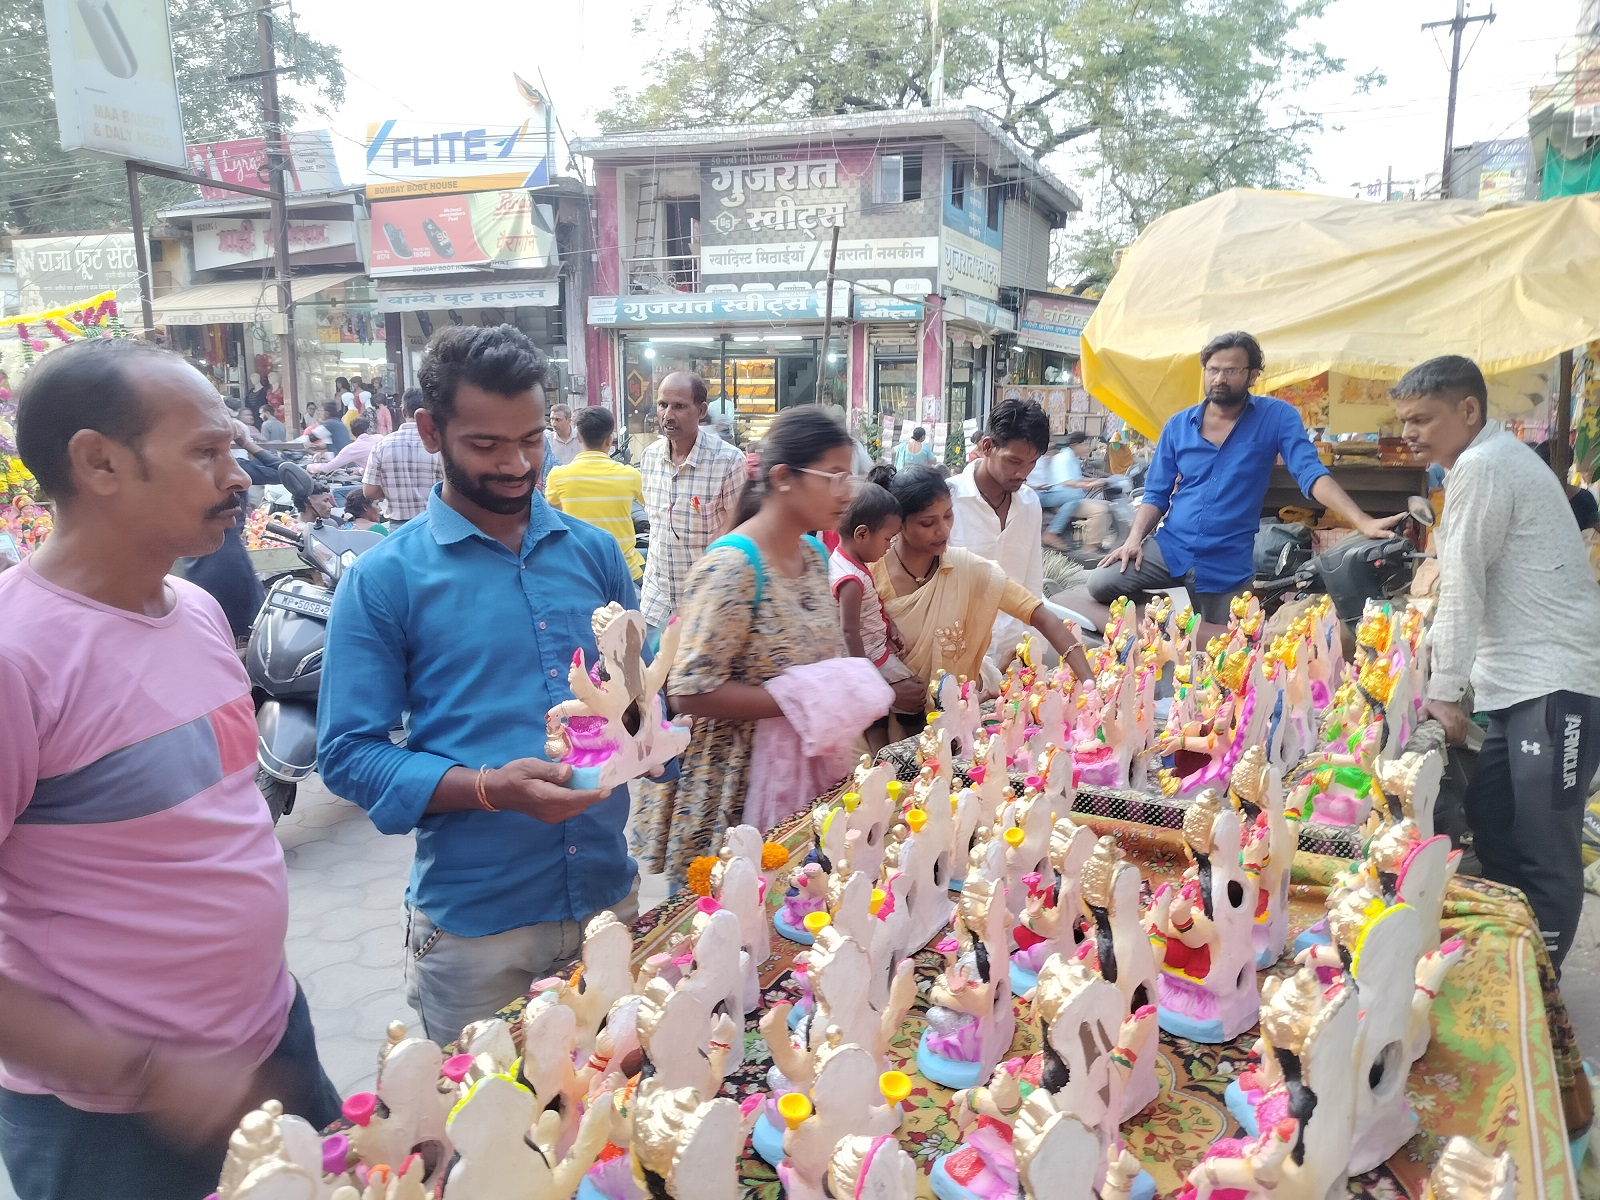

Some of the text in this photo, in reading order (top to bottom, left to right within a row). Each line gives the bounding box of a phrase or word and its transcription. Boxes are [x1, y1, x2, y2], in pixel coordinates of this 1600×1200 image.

[93, 122, 102, 137] &
[374, 180, 458, 195] BOMBAY BOOT HOUSE
[710, 158, 840, 208] गुजरात
[746, 195, 849, 239] स्वीट्स
[37, 249, 73, 272] राजा
[876, 241, 926, 262] नमकीन
[623, 293, 811, 321] गुजरात स्वीट्स
[1563, 718, 1582, 790] ARMOUR
